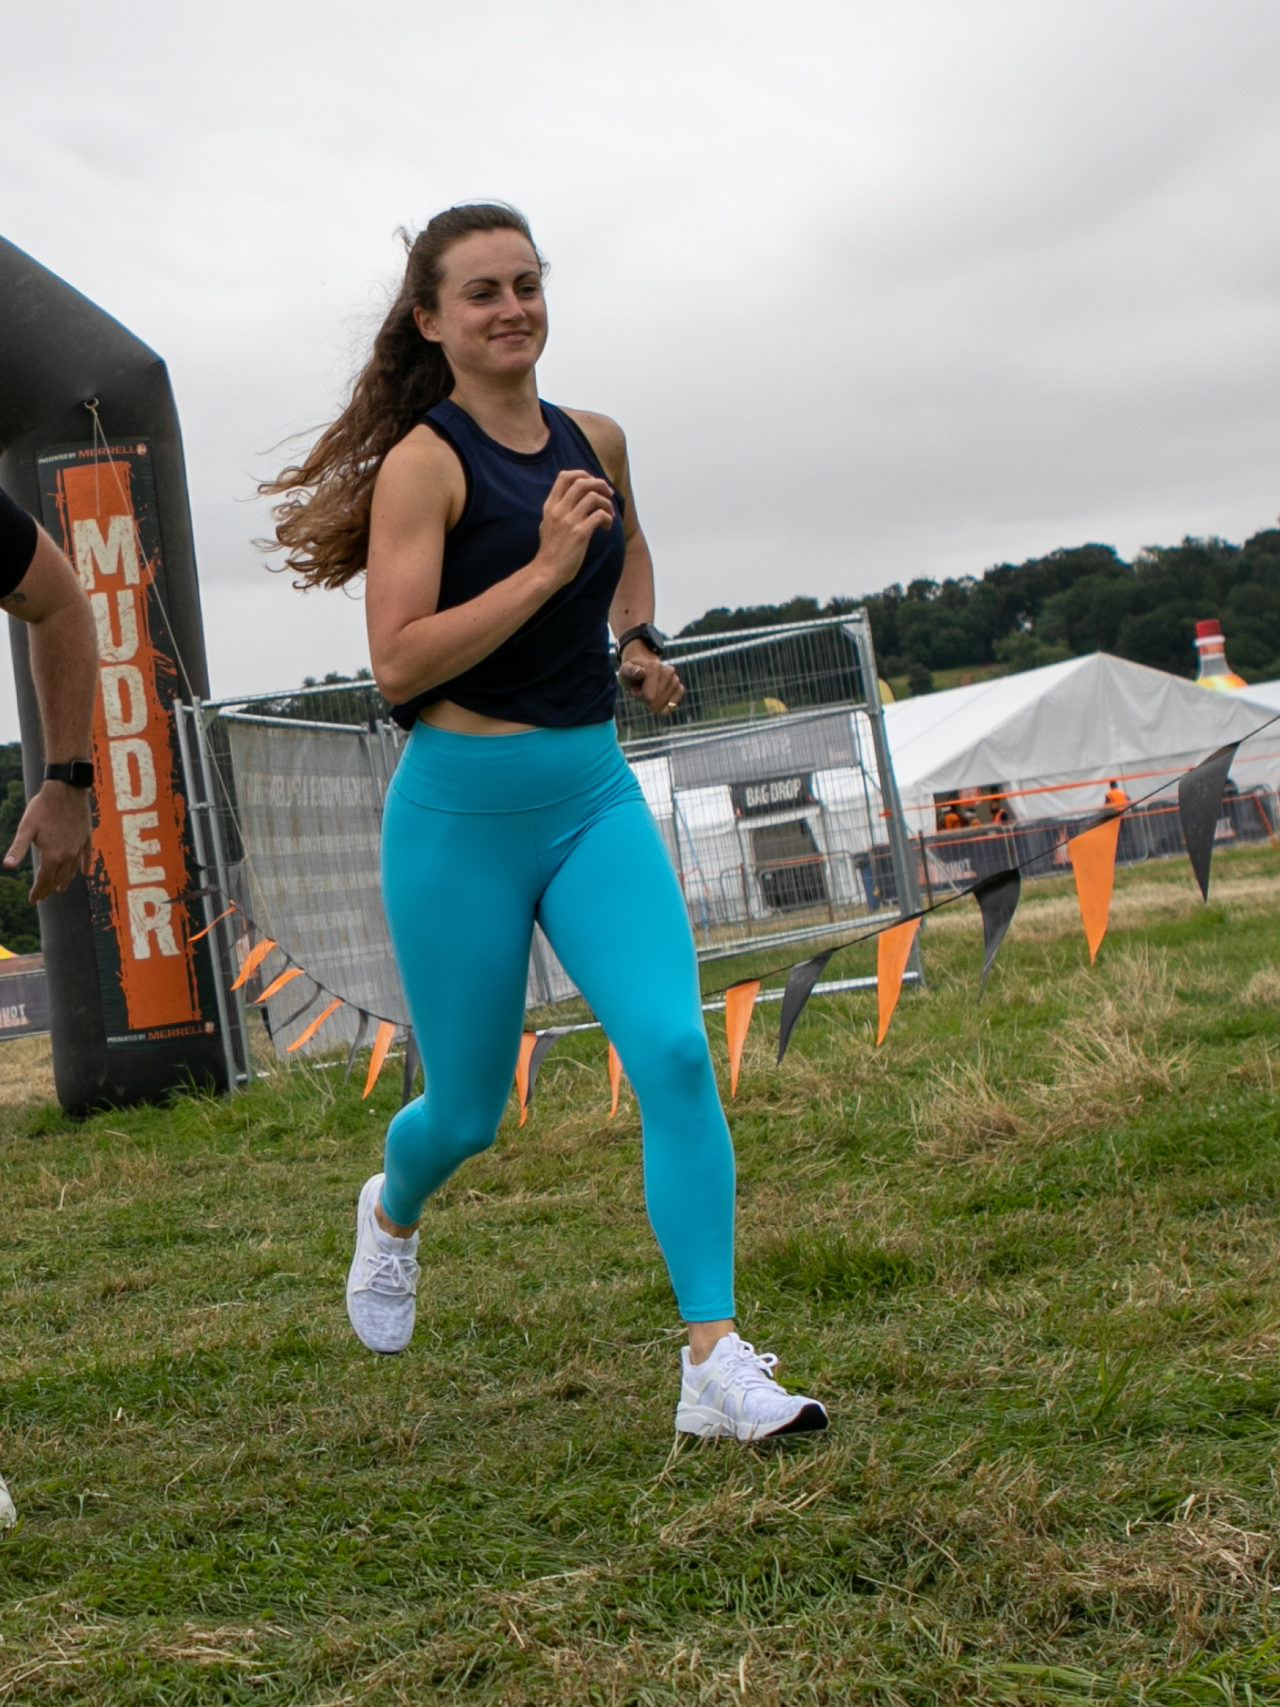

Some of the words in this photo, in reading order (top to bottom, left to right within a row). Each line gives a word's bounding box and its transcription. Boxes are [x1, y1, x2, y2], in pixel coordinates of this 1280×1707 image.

[77, 445, 137, 458] MERRELL
[72, 514, 182, 960] MUDDER
[745, 784, 769, 808] BAG
[771, 778, 802, 803] DROP
